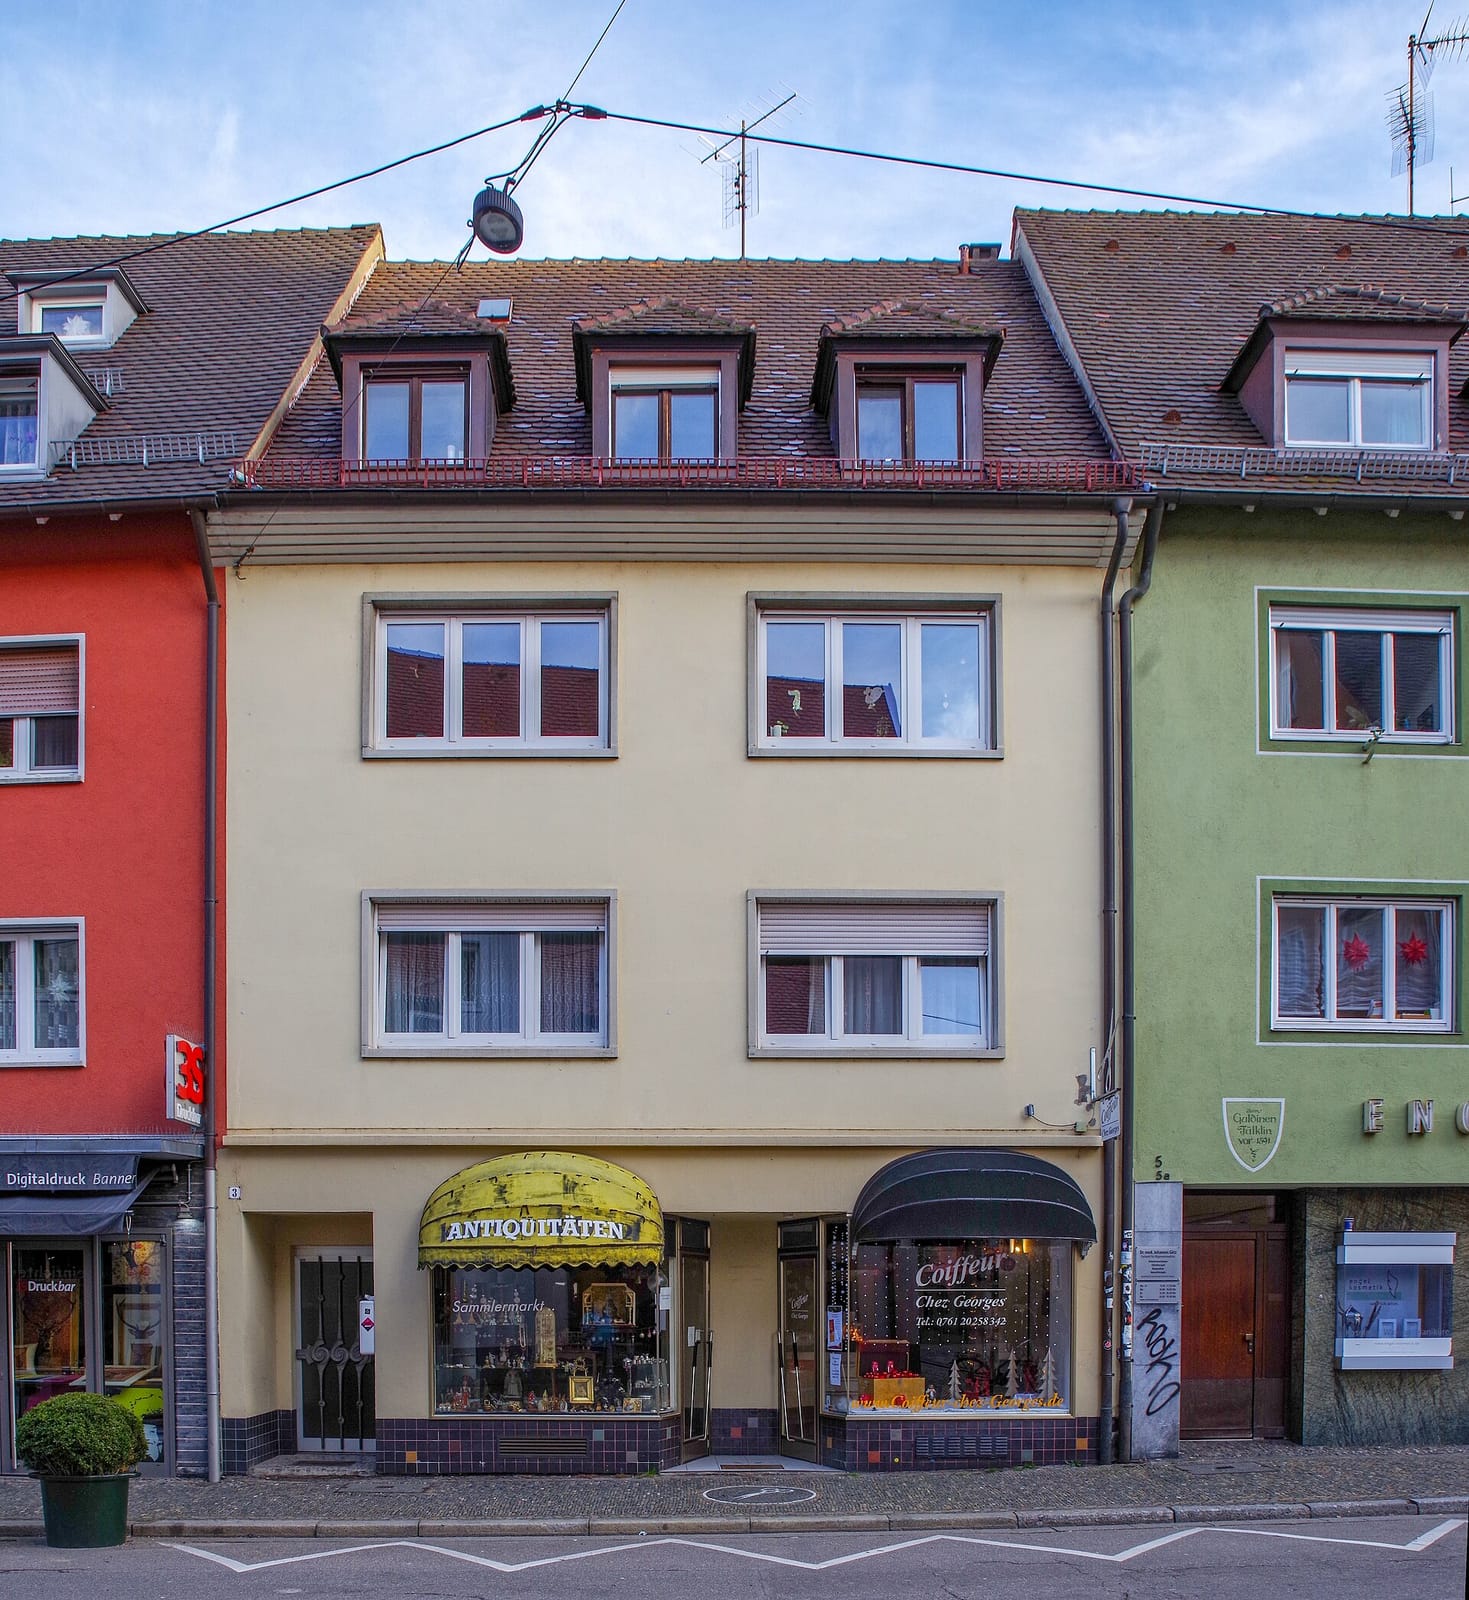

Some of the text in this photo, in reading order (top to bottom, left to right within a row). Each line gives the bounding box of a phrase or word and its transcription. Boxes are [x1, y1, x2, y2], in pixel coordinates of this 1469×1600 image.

[177, 1040, 204, 1104] 3S
[1154, 1155, 1163, 1168] 5
[7, 1173, 136, 1187] Digitaldruck Banner
[1155, 1171, 1170, 1181] 5a
[231, 1188, 238, 1198] 3
[915, 1252, 1007, 1287] Coiffeur
[28, 1280, 76, 1292] Druckbar
[452, 1299, 545, 1313] Sammlermarkt
[915, 1295, 1006, 1310] Chez Georges
[916, 1317, 934, 1326] Tel.:
[936, 1317, 958, 1326] 0761
